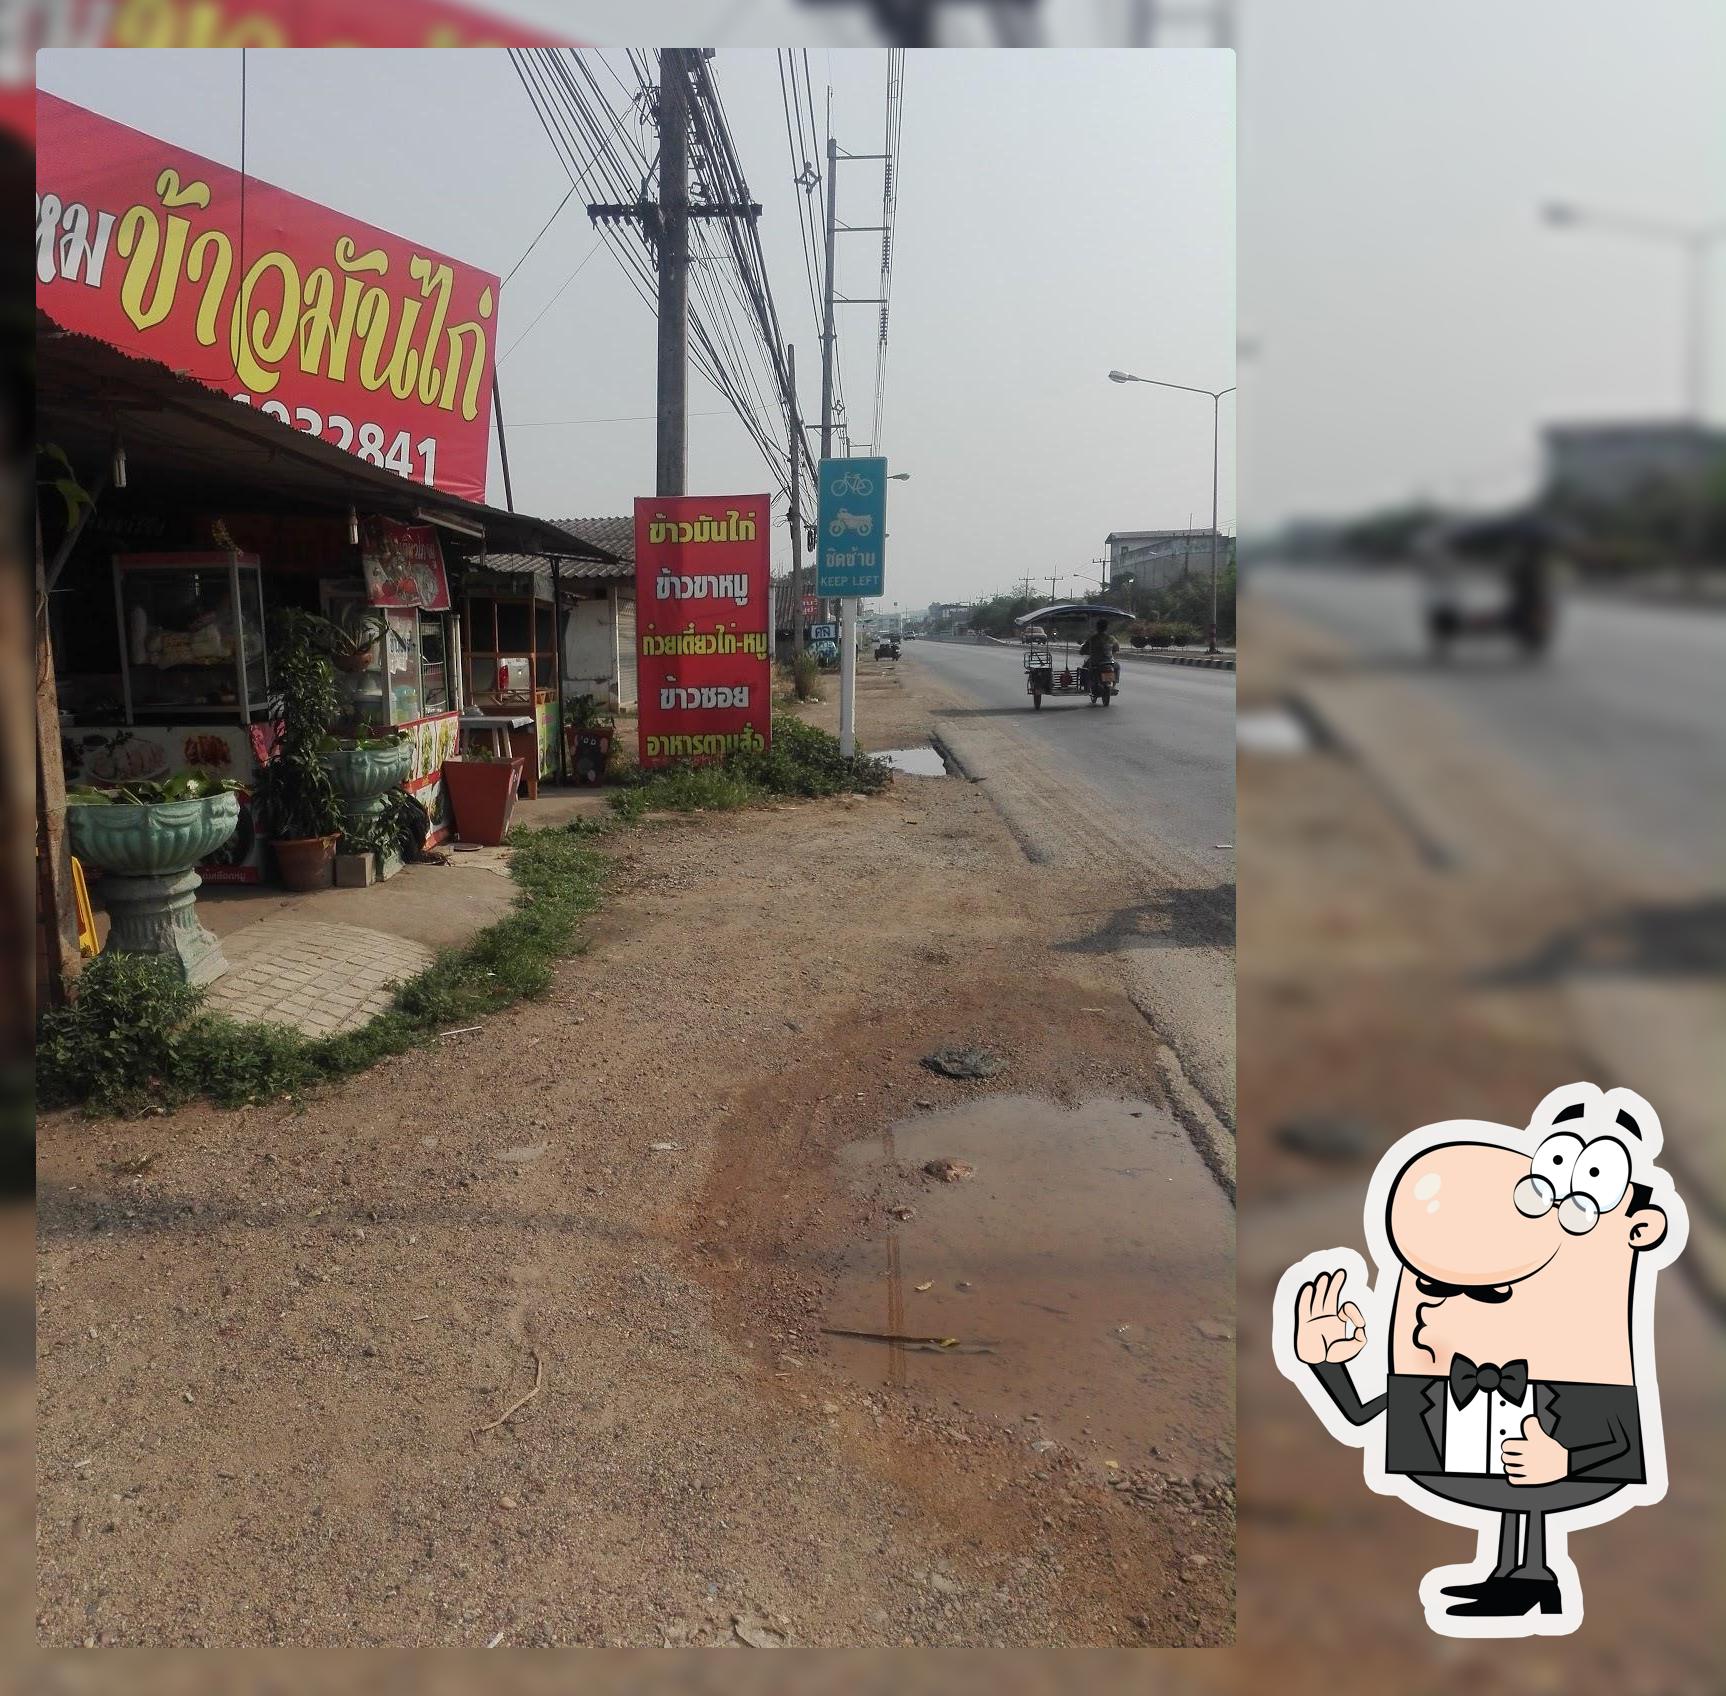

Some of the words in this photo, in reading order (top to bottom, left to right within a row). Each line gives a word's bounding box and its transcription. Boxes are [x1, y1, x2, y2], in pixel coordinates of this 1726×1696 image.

[117, 169, 493, 421] ข้าวมันไก่
[649, 510, 756, 544] ข้าวมันไก่
[656, 567, 748, 606] ข้าวขาหมู
[821, 576, 848, 587] KEEP
[852, 576, 880, 586] LEFT
[660, 675, 749, 709] ข้าวซอย
[647, 722, 765, 756] อาหารตามสั่ง
